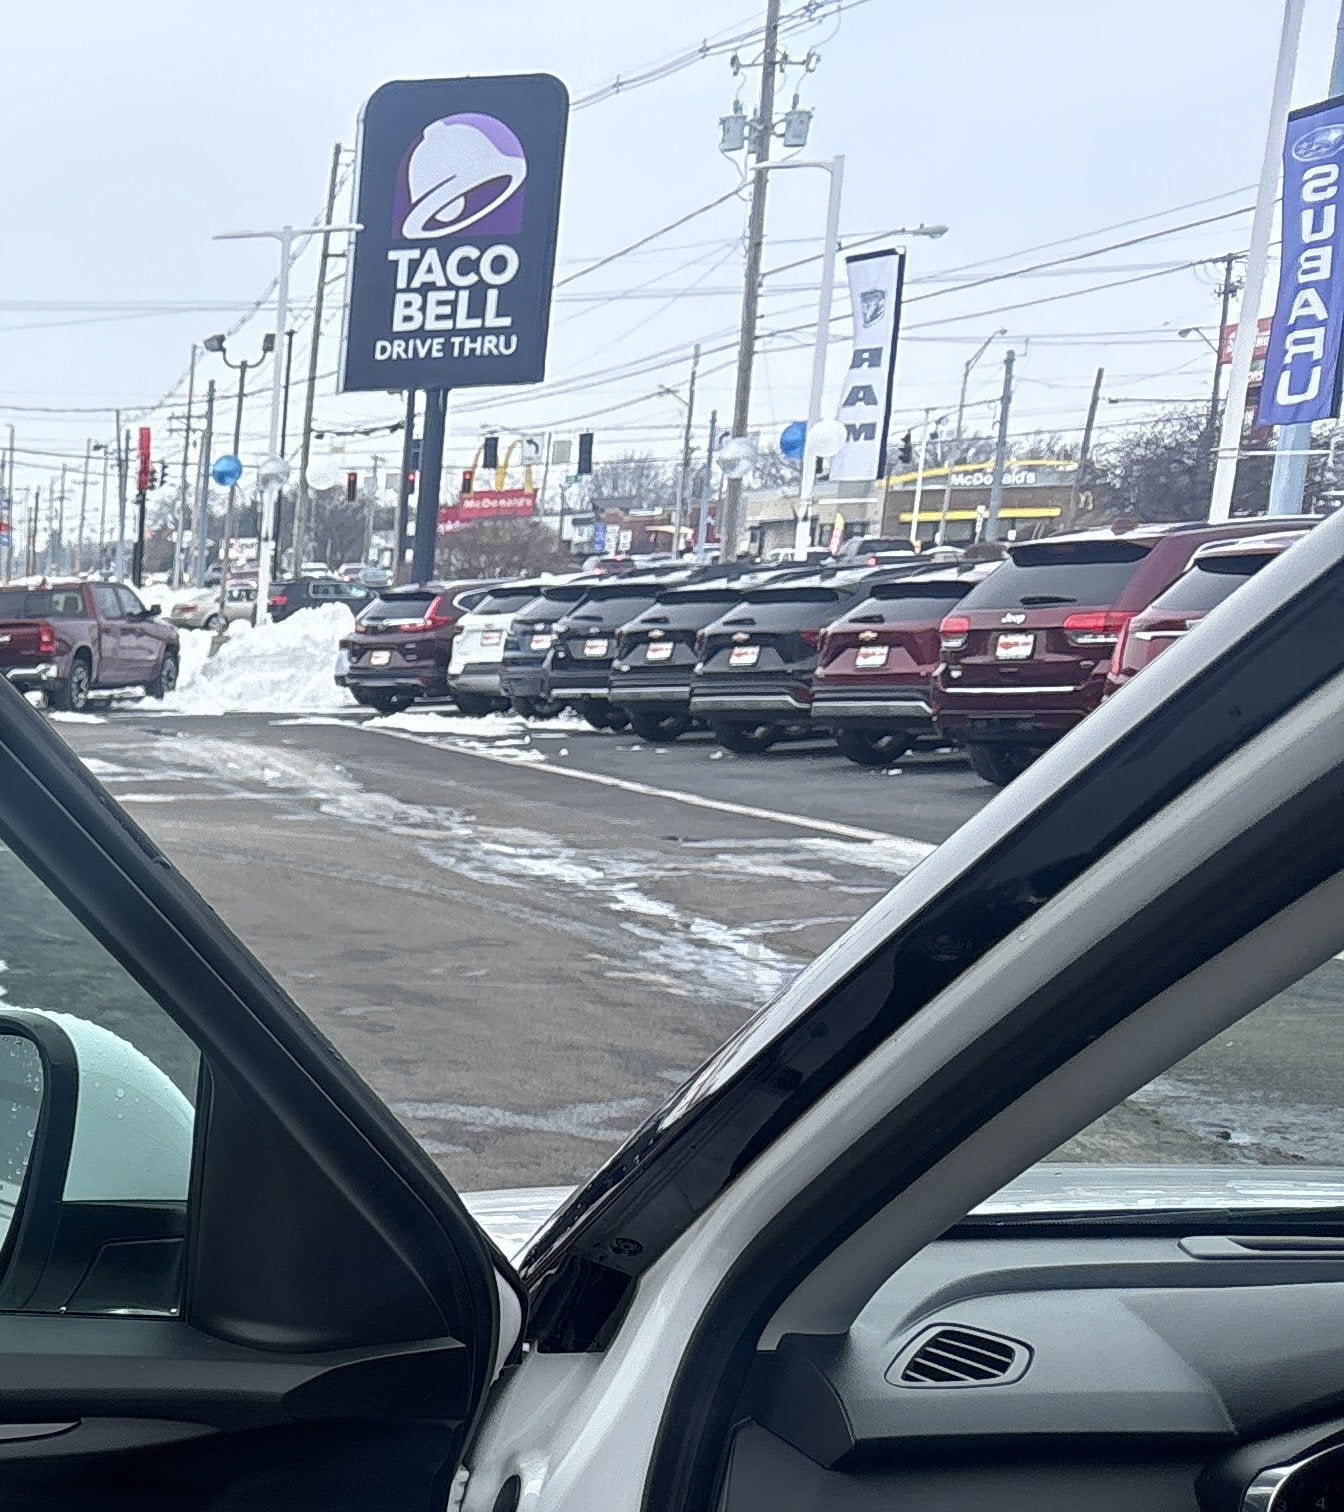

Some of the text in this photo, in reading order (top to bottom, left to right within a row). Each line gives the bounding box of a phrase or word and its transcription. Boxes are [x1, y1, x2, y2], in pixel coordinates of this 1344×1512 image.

[387, 244, 520, 289] TACO
[392, 288, 513, 333] BELL
[374, 334, 518, 361] DRIVE THRU
[951, 471, 1036, 486] McDoald's
